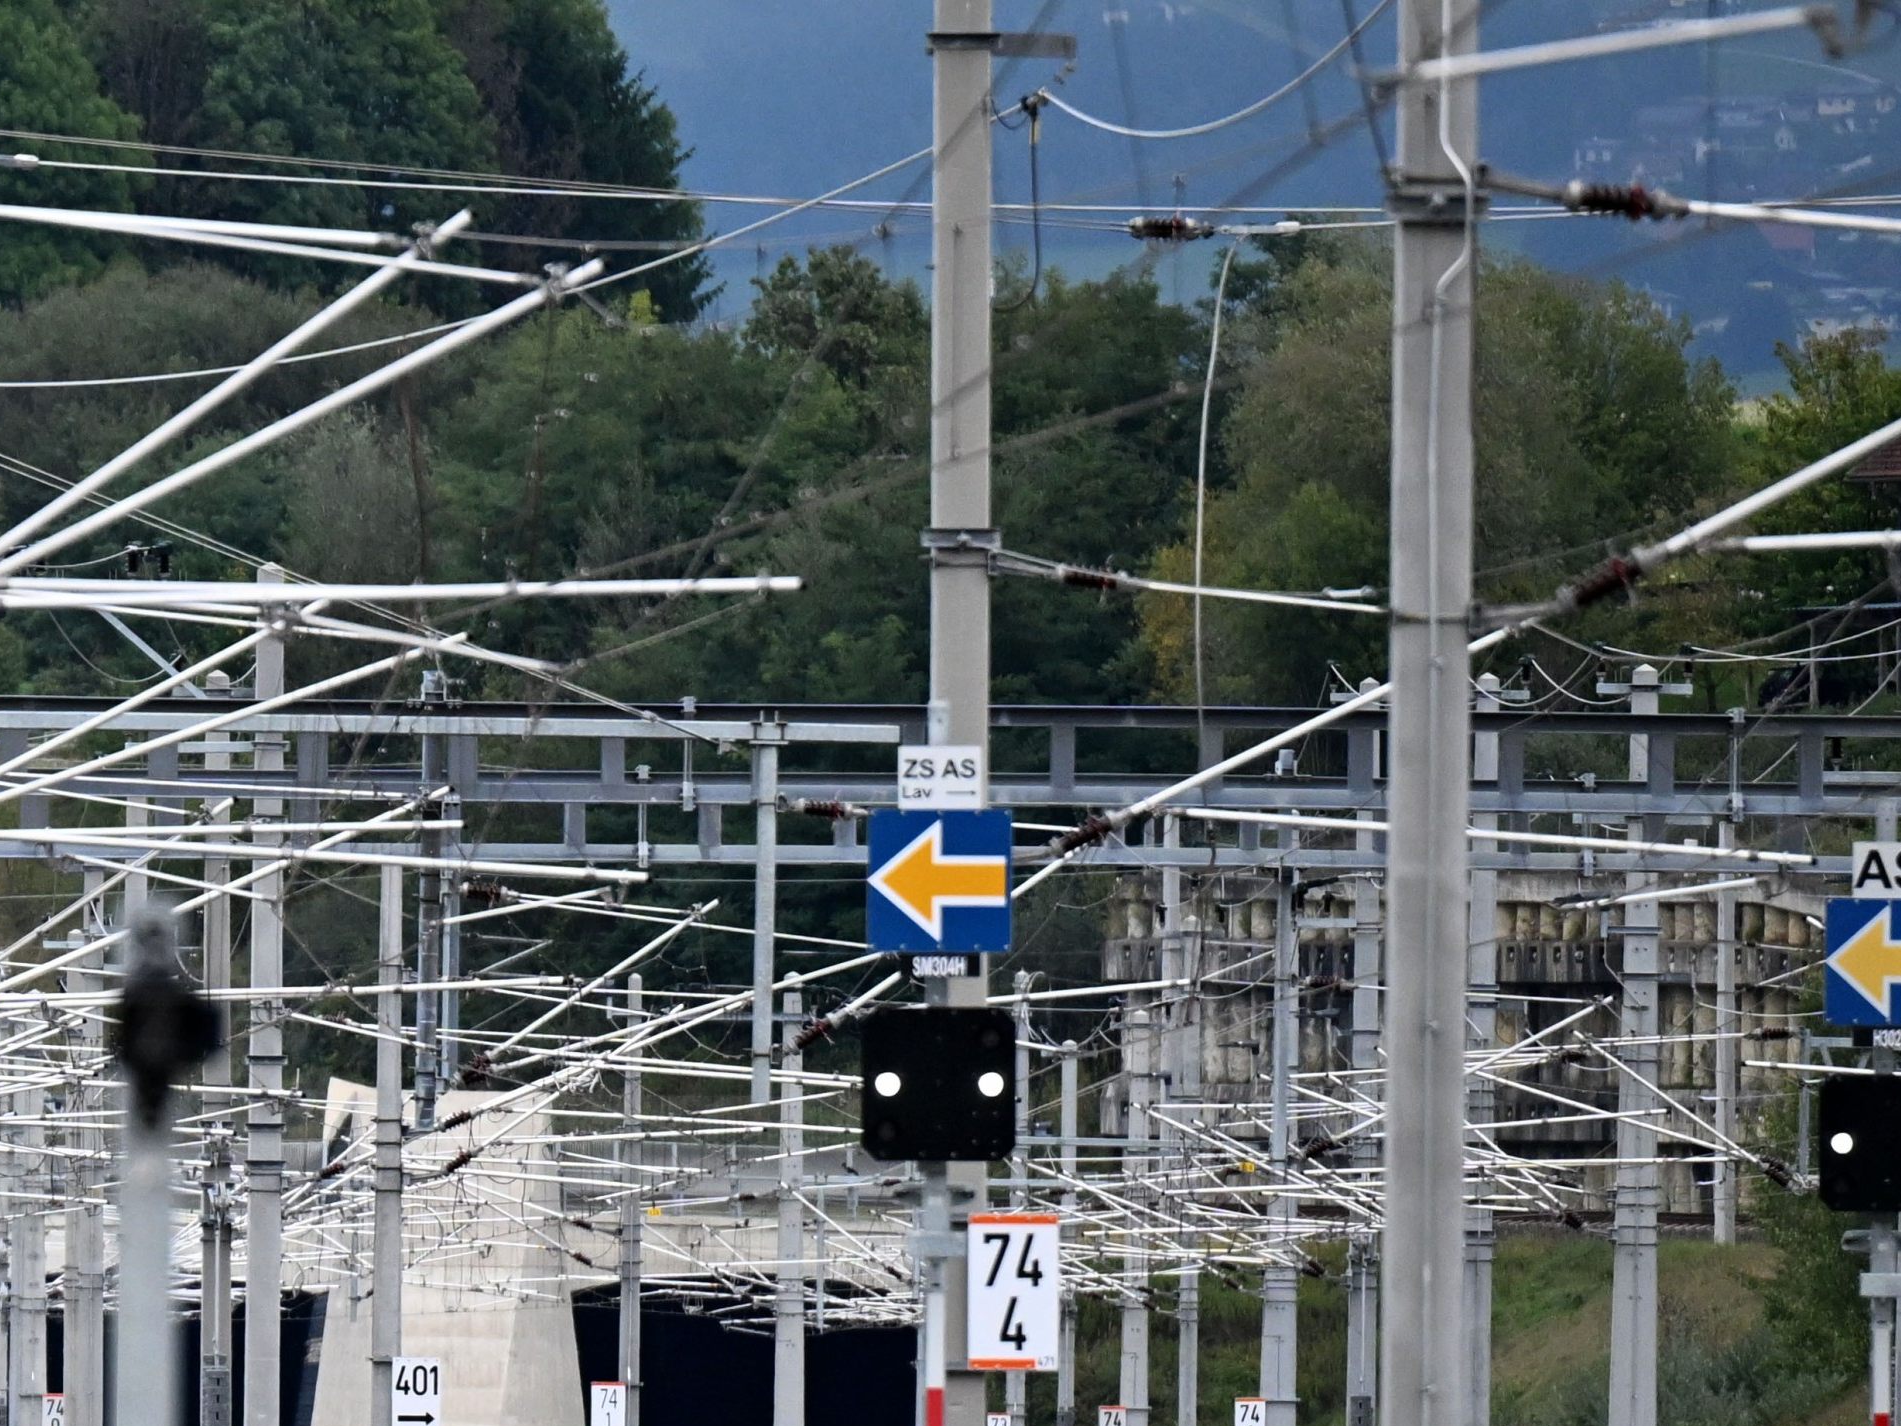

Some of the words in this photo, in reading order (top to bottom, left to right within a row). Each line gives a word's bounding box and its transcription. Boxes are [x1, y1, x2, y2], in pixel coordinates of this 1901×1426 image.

[903, 758, 935, 778] ZS
[942, 758, 976, 778] AS
[902, 785, 932, 798] Lav
[983, 1233, 1043, 1287] 74
[1000, 1296, 1027, 1351] 4
[395, 1365, 439, 1396] 401
[46, 1399, 63, 1415] 74
[600, 1388, 618, 1408] 74
[1240, 1405, 1260, 1423] 74
